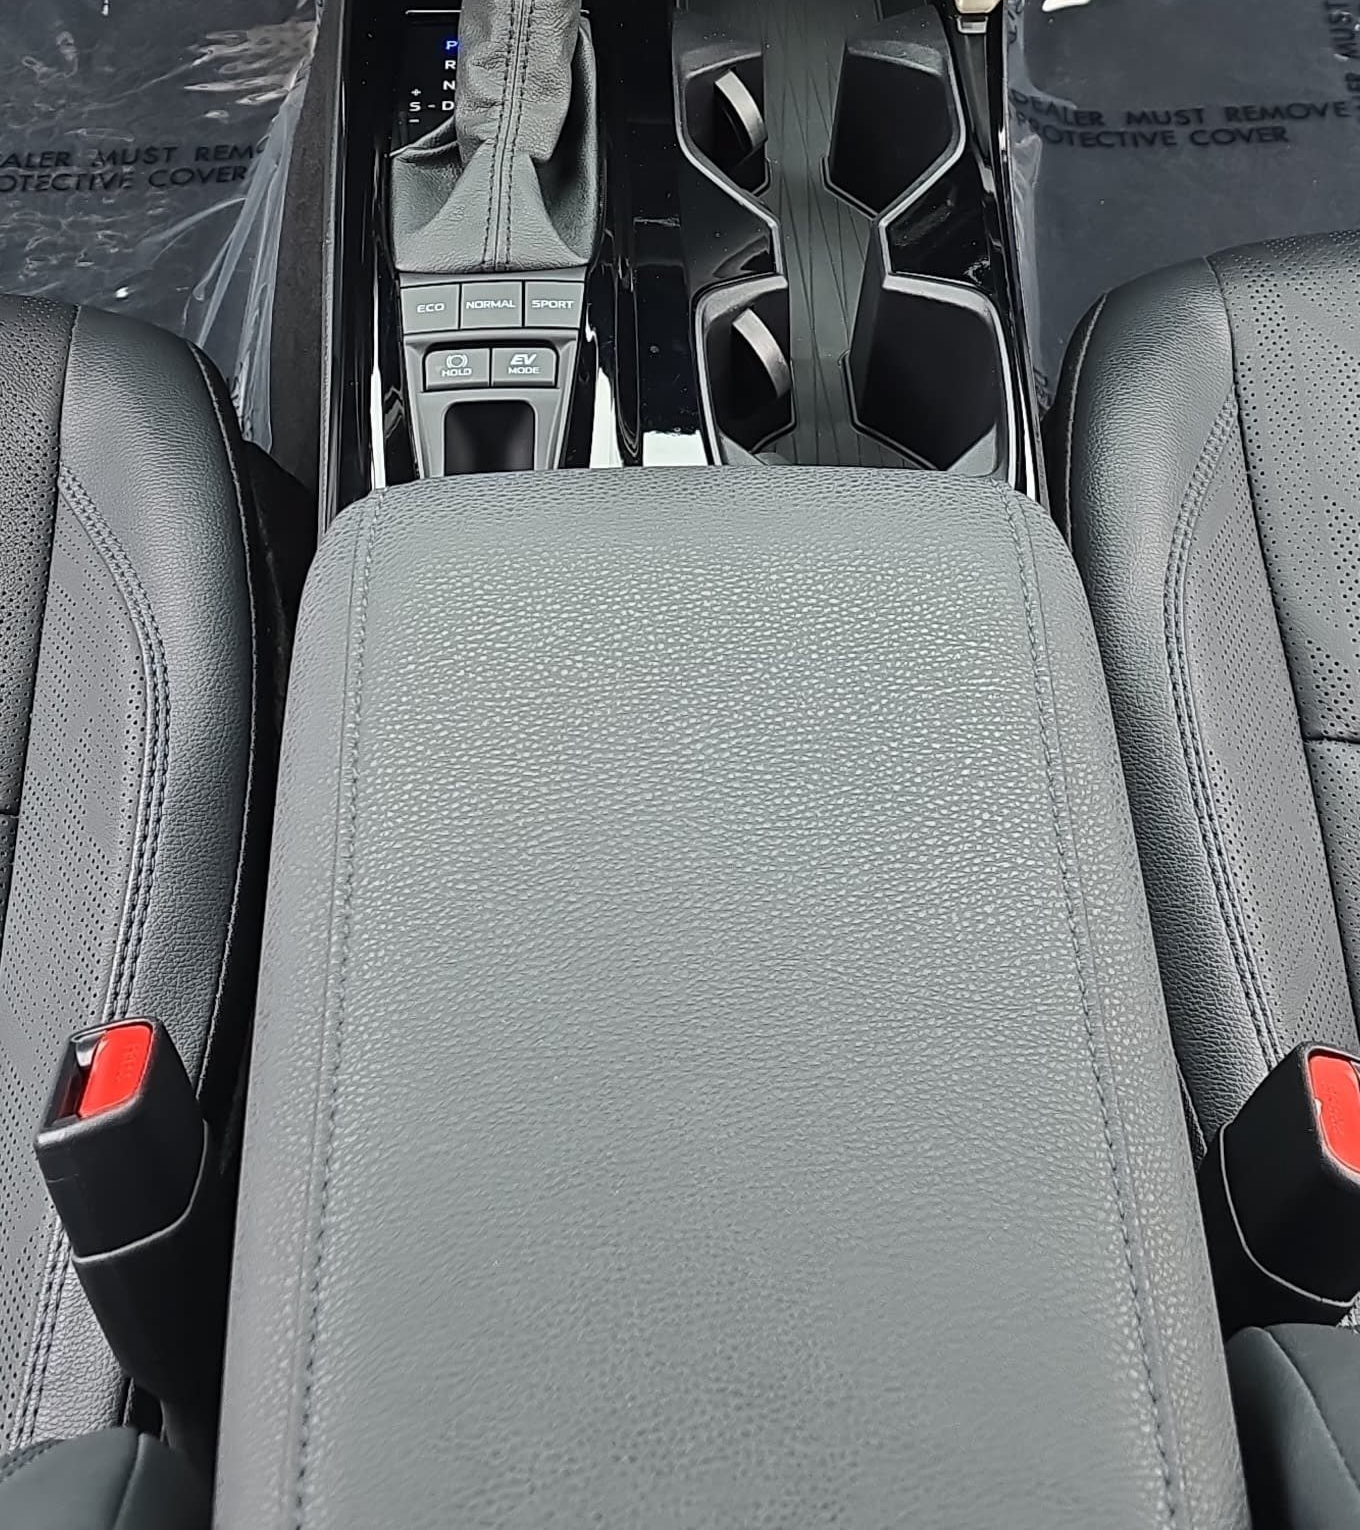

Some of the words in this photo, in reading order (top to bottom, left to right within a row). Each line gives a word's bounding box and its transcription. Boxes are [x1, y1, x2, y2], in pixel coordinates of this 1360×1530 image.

[446, 40, 457, 50] P
[445, 60, 456, 70] R
[443, 80, 456, 90] N
[409, 102, 421, 112] S
[442, 100, 455, 111] D
[1009, 89, 1105, 126] DEALER
[1124, 108, 1206, 125] MUST
[1224, 101, 1352, 122] REMOVE
[1190, 126, 1290, 146] COVER
[93, 146, 179, 167] MUST
[148, 165, 247, 188] COVER
[416, 303, 445, 313] ECO
[465, 299, 516, 310] NORMAL
[531, 299, 574, 310] SPORT
[510, 353, 537, 365] EV
[441, 368, 472, 377] HOLD
[508, 366, 540, 375] MODE
